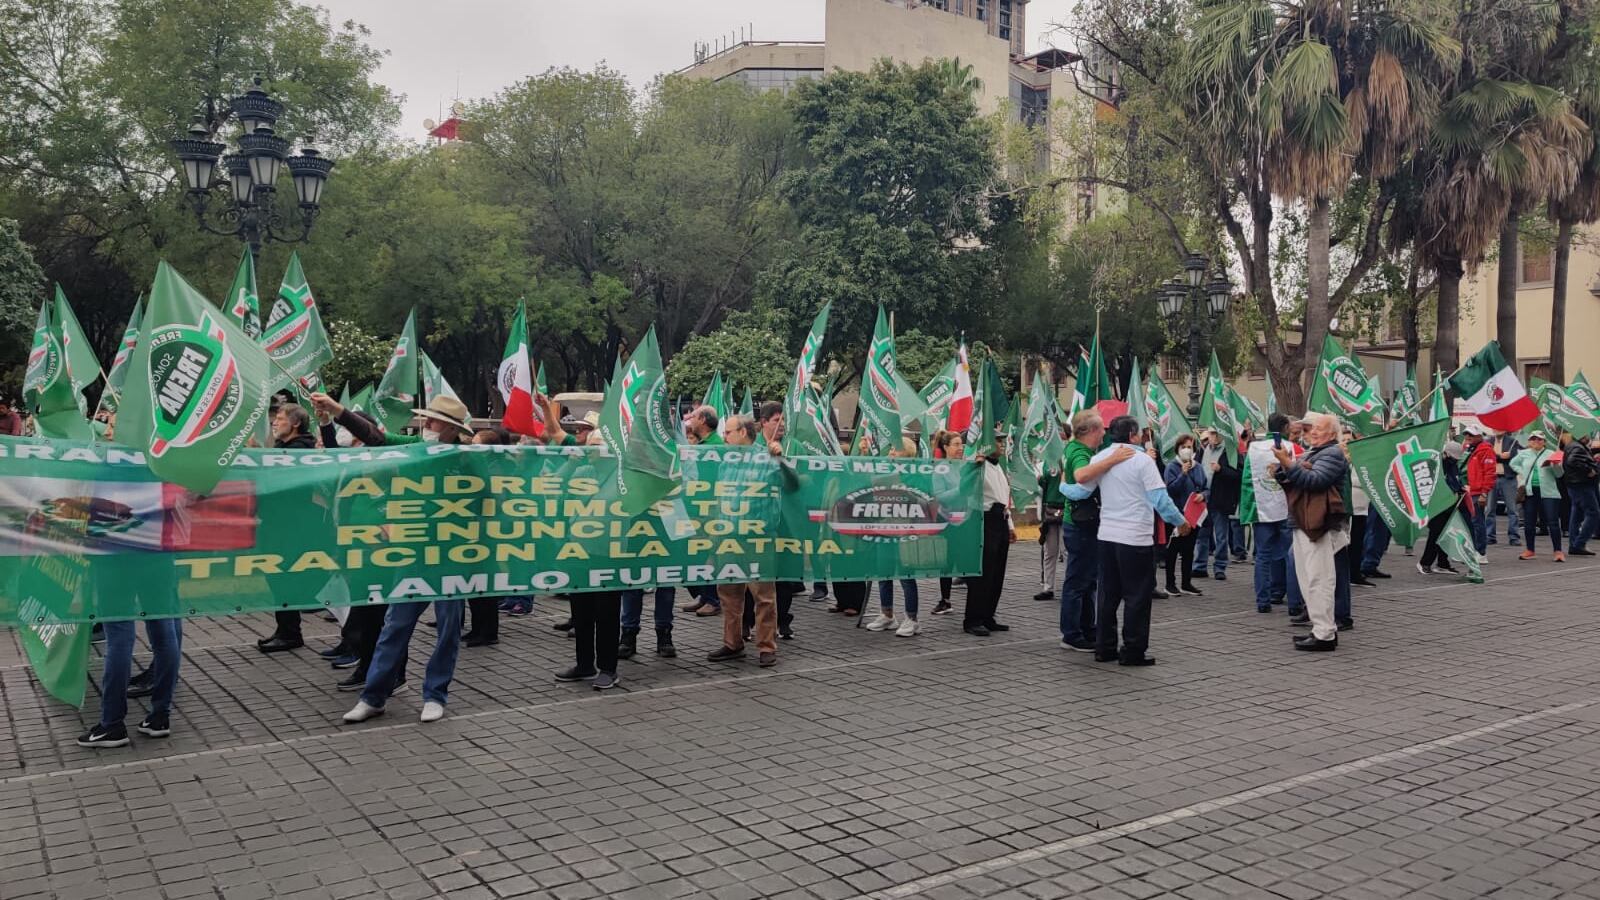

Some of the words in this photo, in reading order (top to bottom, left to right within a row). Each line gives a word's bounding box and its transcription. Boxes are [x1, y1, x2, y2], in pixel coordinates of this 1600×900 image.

[1333, 369, 1363, 398] FRENA
[230, 450, 410, 467] ARCHA
[536, 446, 586, 457] LA
[808, 459, 845, 472] DE
[853, 460, 950, 475] MÉXICO
[336, 473, 600, 498] ANDRÉS
[667, 480, 780, 498] PEZ:
[1412, 461, 1434, 506] FRENA
[692, 501, 750, 516] TU
[852, 503, 925, 518] FRENA
[336, 520, 658, 546] RENUNCIA
[675, 519, 767, 536] POR
[173, 540, 536, 579] TRAICIÓN
[556, 542, 590, 560] A
[609, 541, 671, 558] LA
[687, 538, 854, 555] PATRIA.
[367, 570, 571, 604] ¡AMLO
[589, 562, 761, 587] FUERA!
